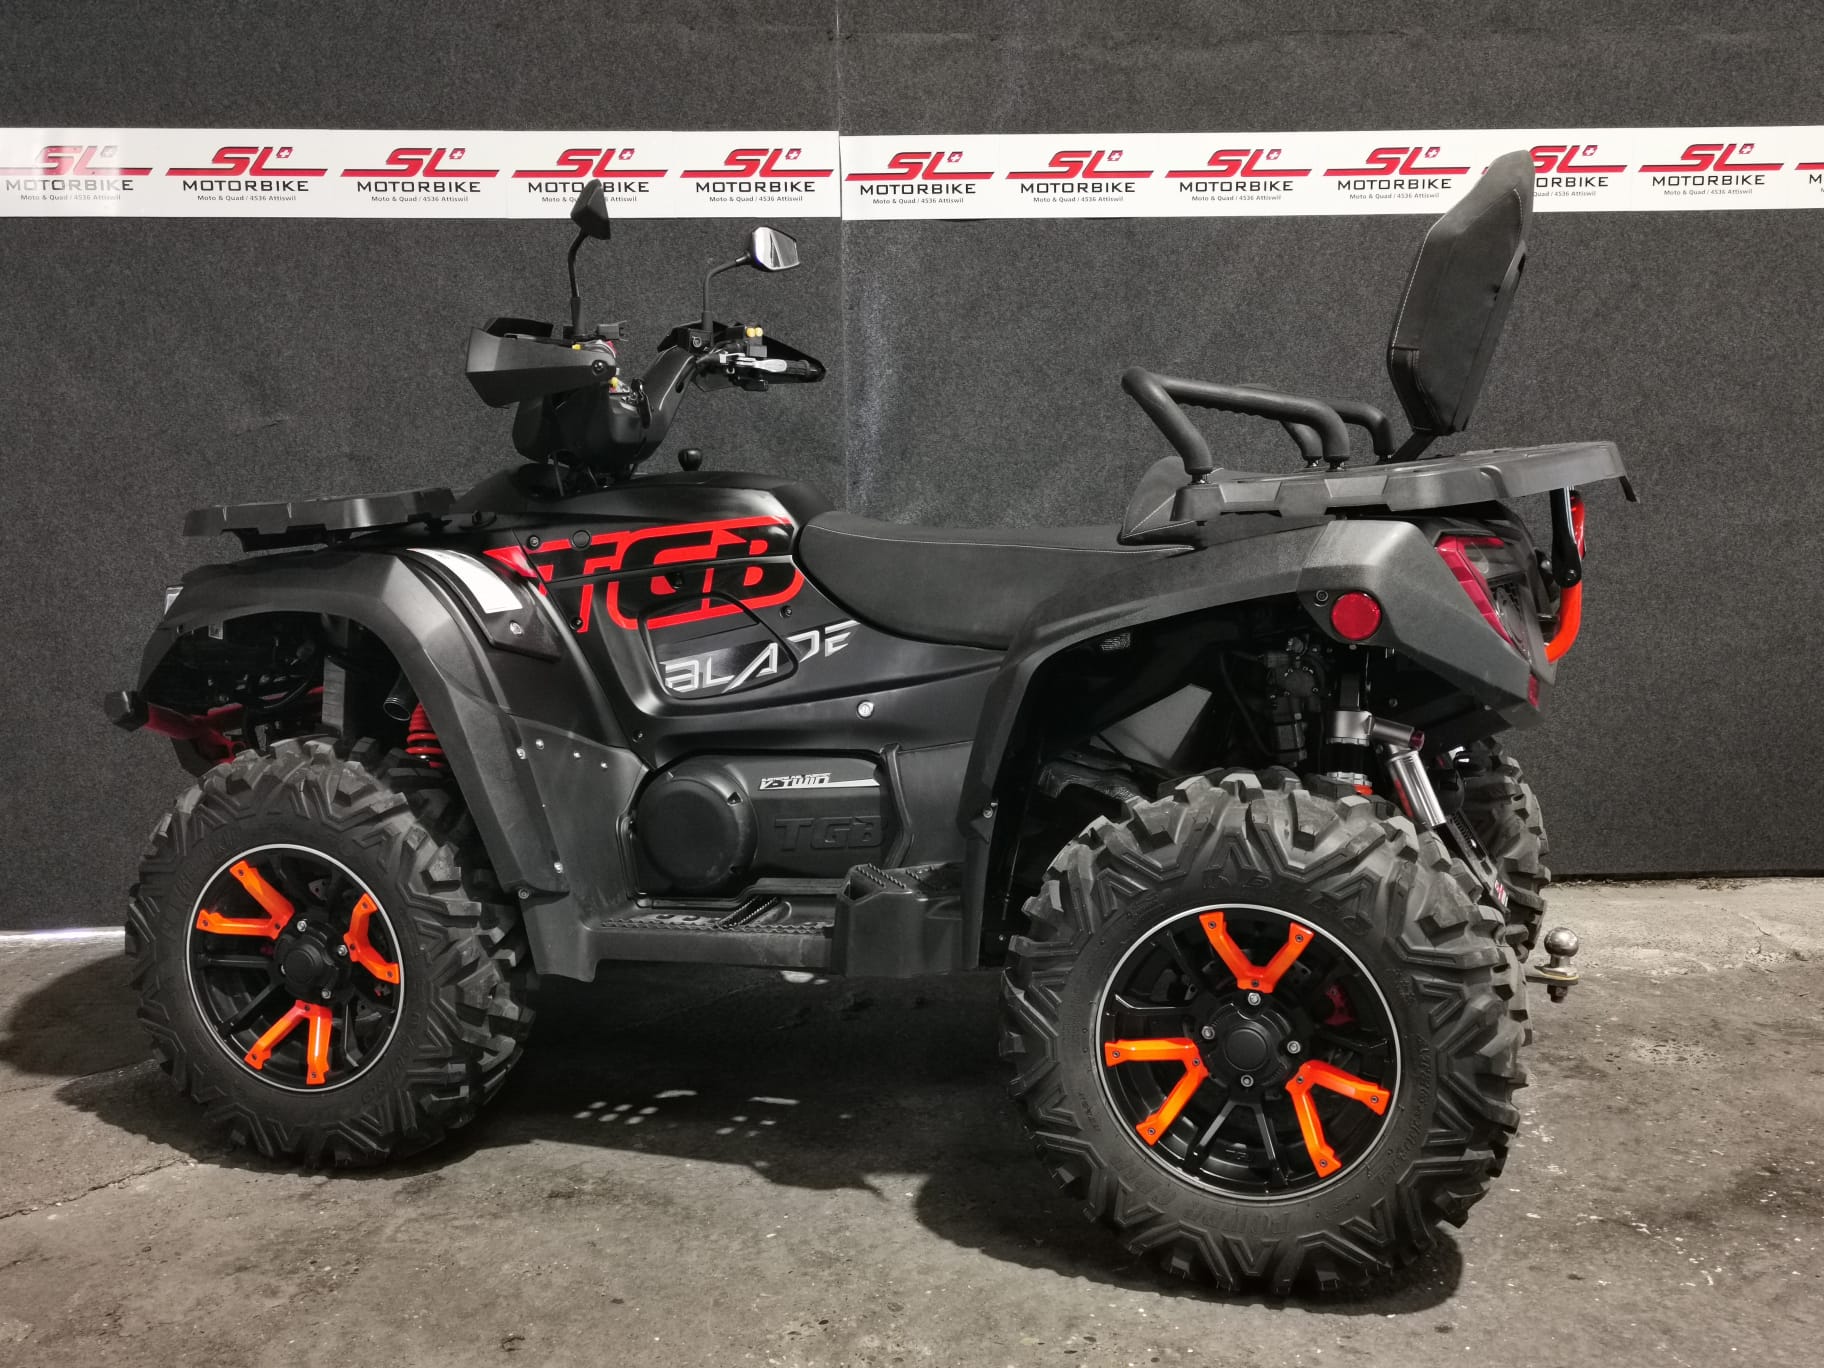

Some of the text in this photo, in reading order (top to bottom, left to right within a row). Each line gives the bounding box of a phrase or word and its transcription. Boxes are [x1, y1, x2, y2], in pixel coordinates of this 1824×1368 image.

[6, 180, 133, 190] MOTORBIKE
[1338, 179, 1451, 189] MOTORBIKE
[1536, 177, 1609, 187] ORBIKE
[1653, 175, 1764, 186] MOTORBIKE
[183, 181, 308, 191] MOTORBIKE
[358, 182, 480, 192] MOTORBIKE
[528, 182, 649, 192] MOTOBIKE
[696, 182, 815, 192] MOTORBIKE
[861, 184, 976, 194] MOTORBIKE
[1021, 183, 1134, 193] MOTORBIKE
[1180, 181, 1292, 191] MOTORBIKE
[198, 194, 216, 202] Moto
[226, 194, 245, 202] Quad
[250, 194, 267, 202] 4536
[269, 194, 296, 202] Attiswil
[524, 515, 804, 633] TGB
[660, 620, 861, 693] BLADE
[774, 815, 882, 852] TGB
